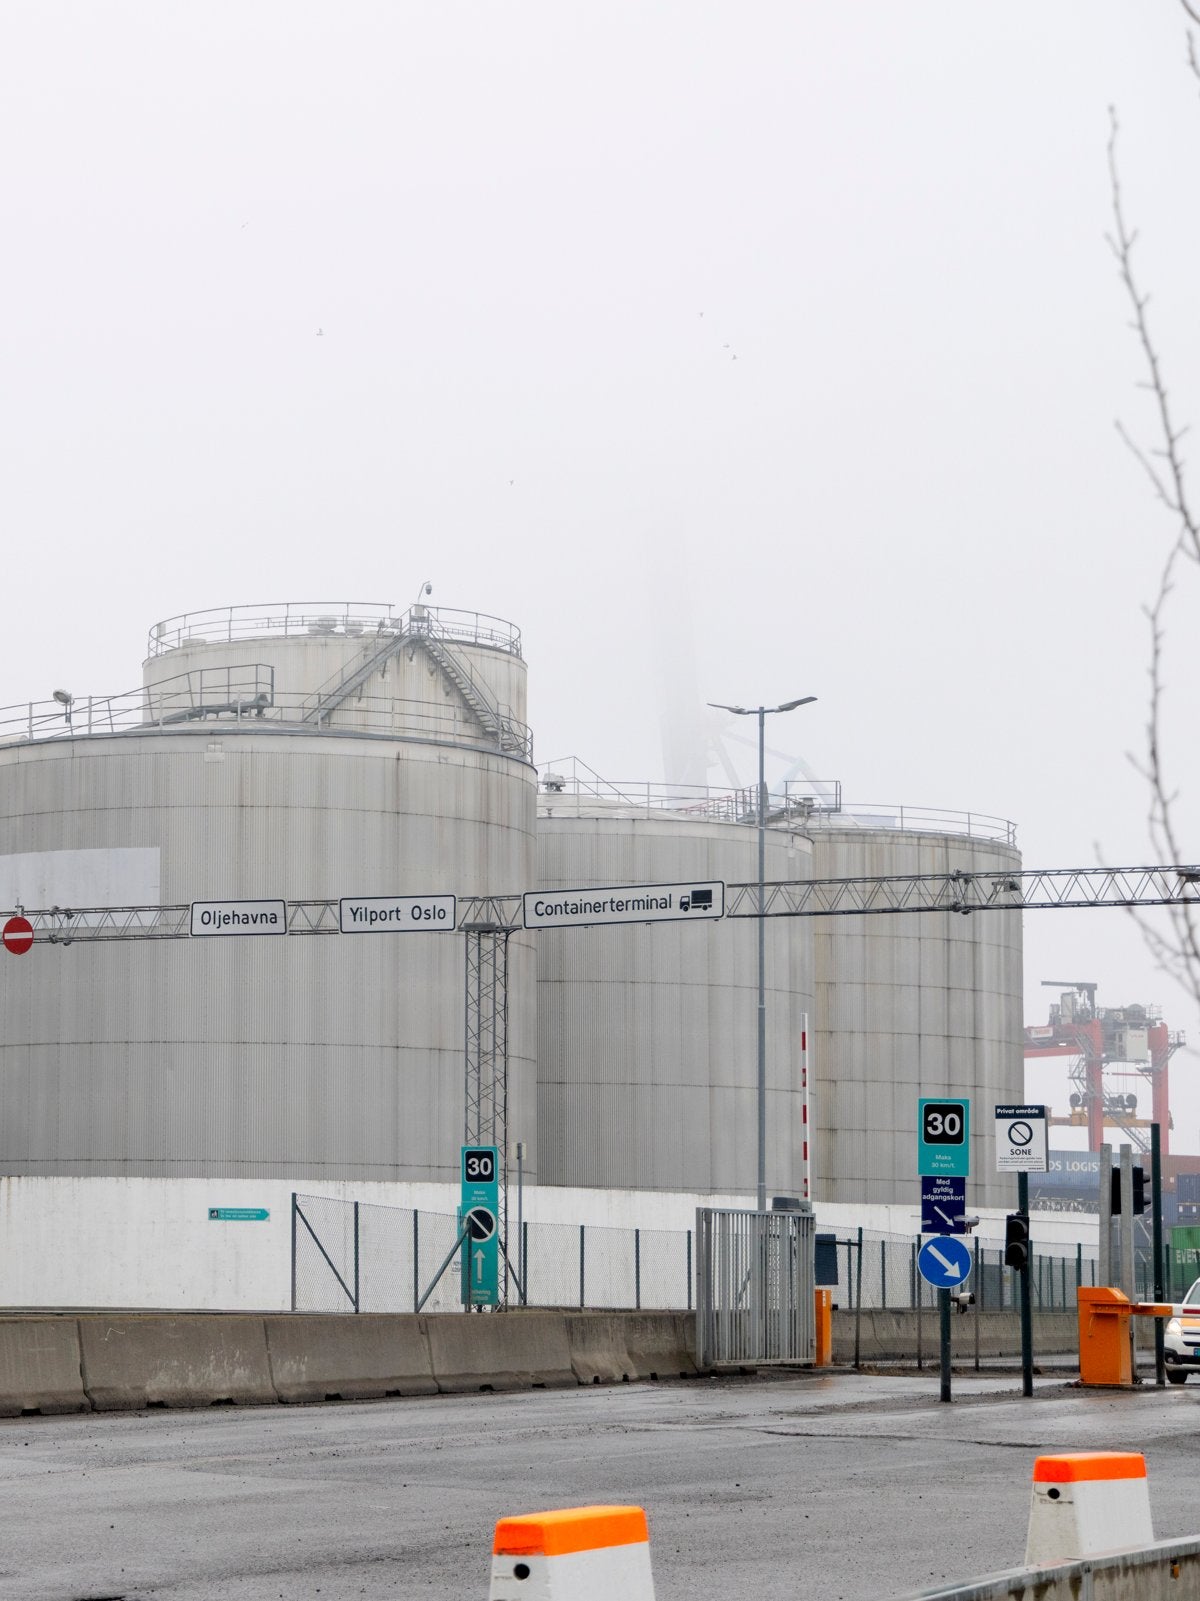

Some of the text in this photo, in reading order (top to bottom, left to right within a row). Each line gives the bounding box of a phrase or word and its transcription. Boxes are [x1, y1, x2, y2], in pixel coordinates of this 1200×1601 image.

[534, 893, 672, 917] Containerterminal
[200, 910, 278, 929] Oljehavna
[350, 905, 446, 926] Yilport Oslo
[926, 1113, 961, 1136] 30
[1010, 1148, 1032, 1156] SONE
[467, 1157, 492, 1176] 30
[932, 1186, 954, 1194] gyldig
[1176, 1248, 1200, 1264] EVER
